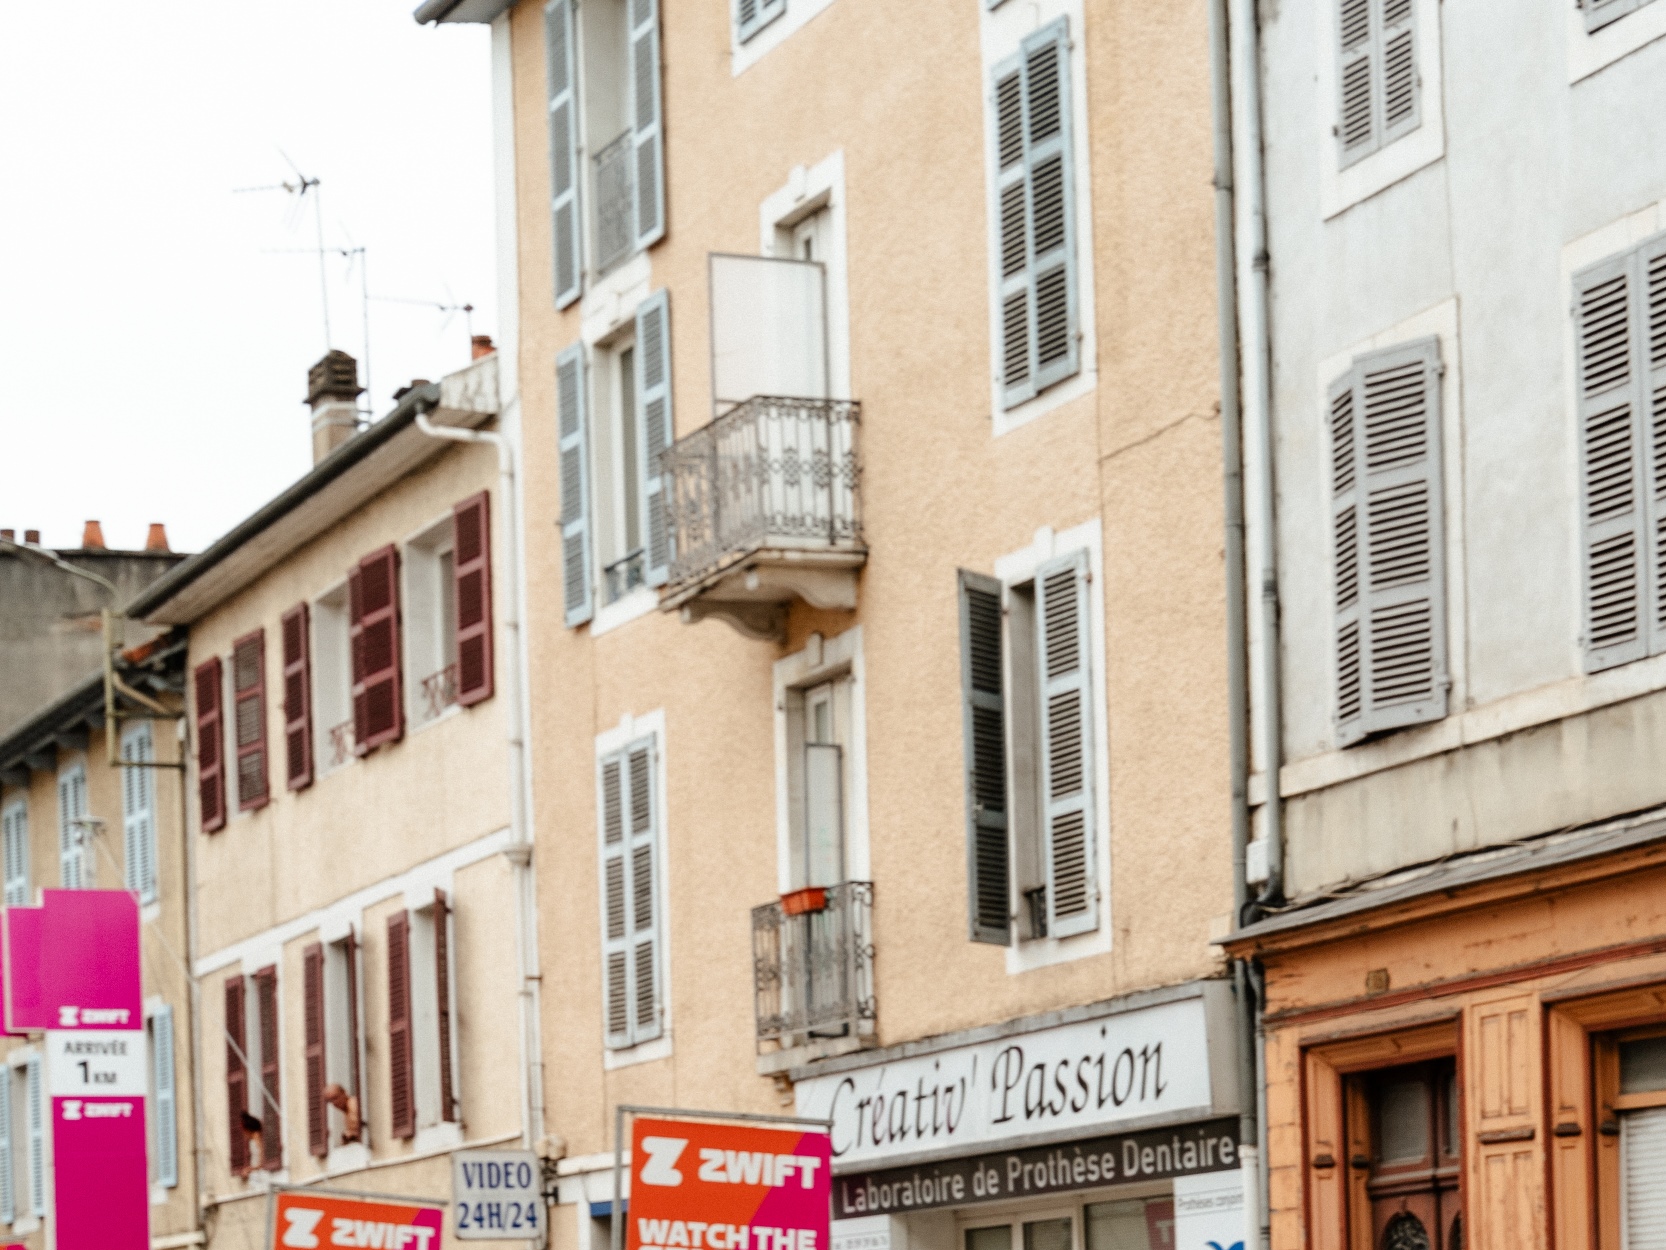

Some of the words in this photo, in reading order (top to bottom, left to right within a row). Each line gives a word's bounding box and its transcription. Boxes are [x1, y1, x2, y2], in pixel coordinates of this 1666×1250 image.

[64, 1039, 127, 1056] ARRIVÉE
[77, 1060, 90, 1084] 1
[94, 1072, 117, 1084] KM
[991, 1025, 1169, 1125] Passion
[462, 1162, 532, 1190] VIDEO
[698, 1147, 822, 1190] ZWIFT
[842, 1169, 965, 1214] Laboratoire
[972, 1163, 999, 1196] de
[1006, 1145, 1116, 1193] Prothèse
[1122, 1127, 1235, 1177] Dentaire
[458, 1202, 538, 1231] 24H/24
[637, 1217, 750, 1250] WATCH
